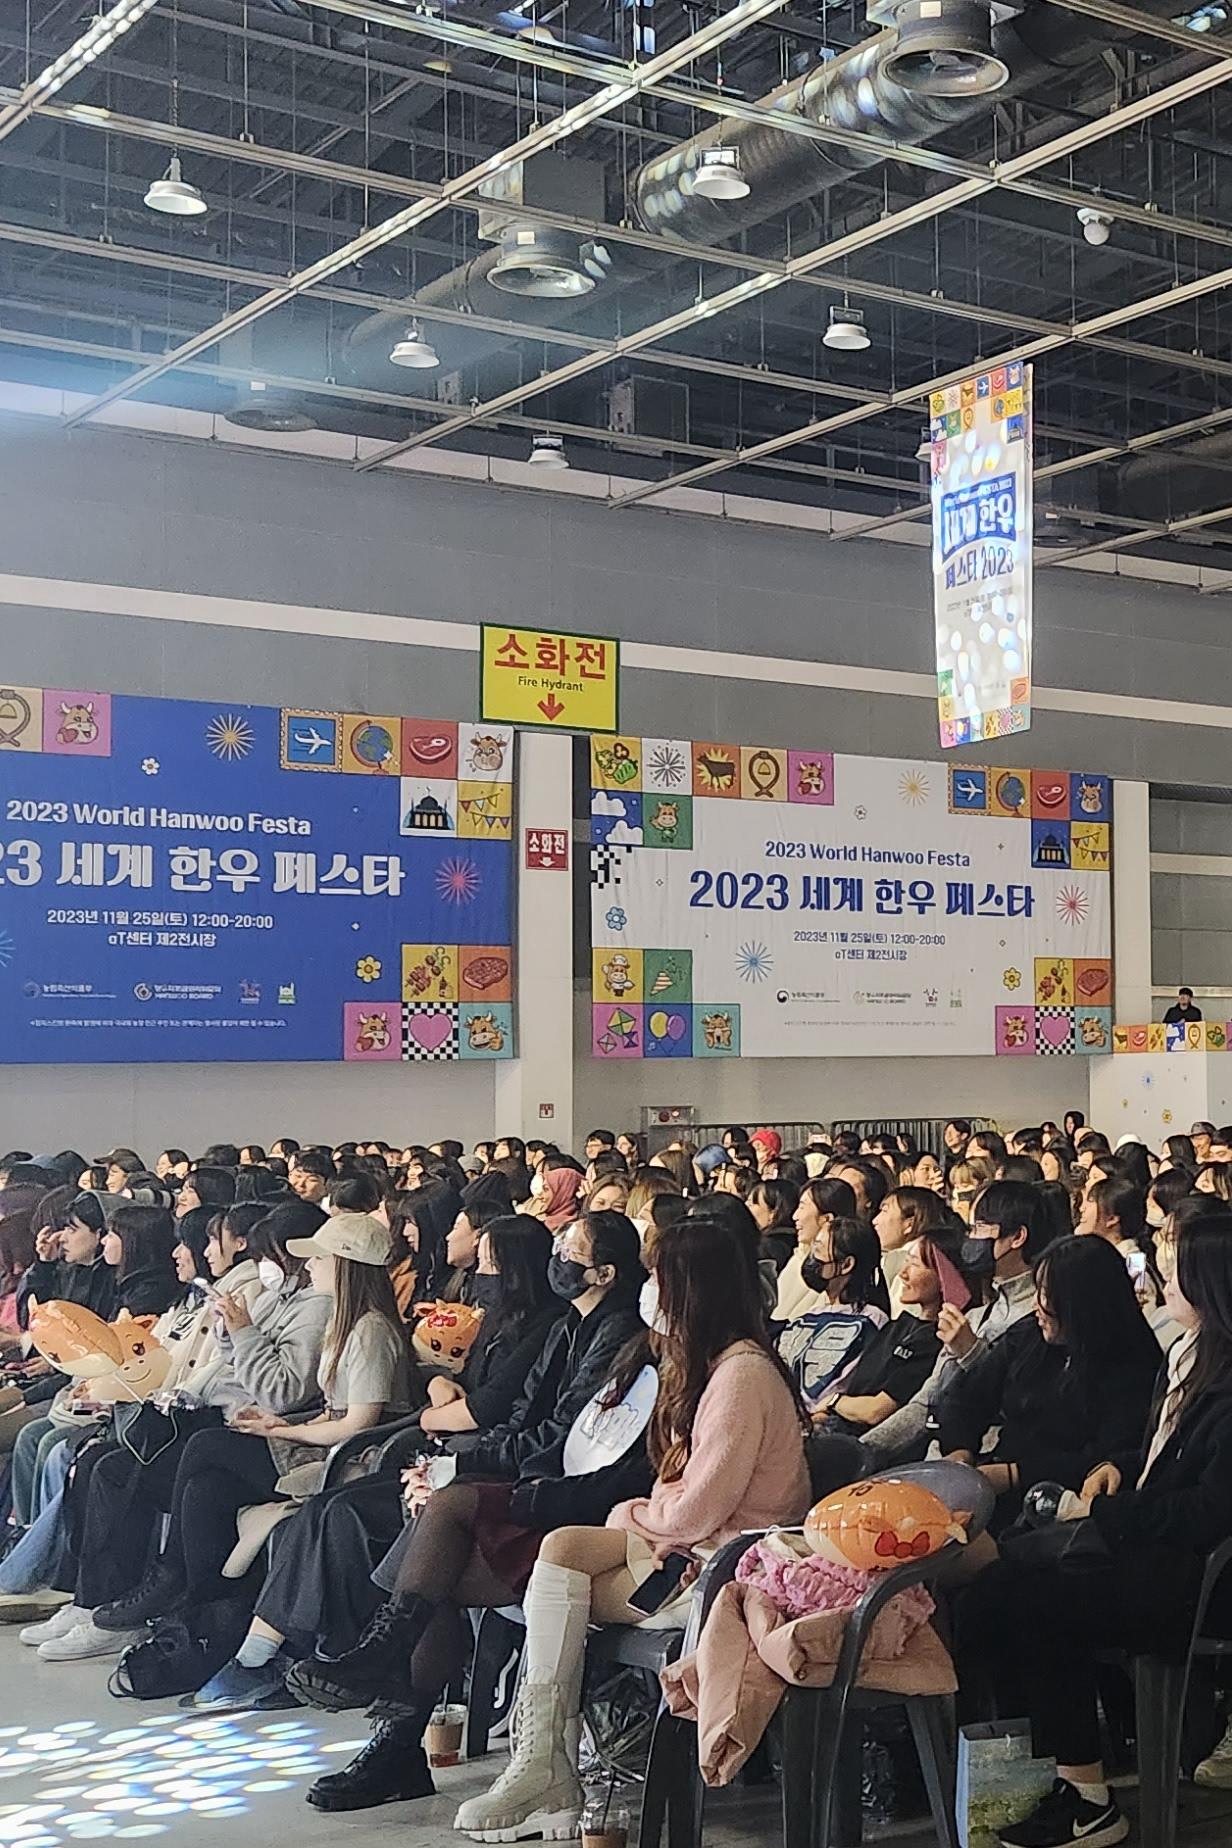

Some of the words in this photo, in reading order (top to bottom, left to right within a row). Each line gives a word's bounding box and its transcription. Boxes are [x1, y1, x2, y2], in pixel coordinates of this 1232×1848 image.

[979, 493, 1014, 534] 한우
[981, 545, 1014, 580] 2023
[494, 633, 606, 680] 소화전
[518, 676, 538, 687] Fire
[541, 679, 584, 692] Hydrant
[6, 800, 68, 823] 2023
[73, 803, 145, 827] World
[150, 808, 243, 832] Hanwoo
[248, 813, 311, 835] Festa
[529, 832, 565, 854] 소화전
[765, 840, 807, 858] 2023
[810, 843, 858, 862] World
[861, 846, 924, 865] Hanwoo
[928, 850, 970, 867] Festa
[0, 839, 43, 887] 3
[56, 841, 153, 888] 세계
[168, 846, 261, 893] 한우
[273, 851, 406, 897] 페스타
[689, 870, 789, 911] 2023
[800, 875, 863, 911] 세계
[874, 878, 937, 915] 한우
[945, 882, 1036, 918] 페스타
[48, 910, 98, 924] 2023년
[102, 910, 129, 925] 11월
[133, 911, 187, 926] 25일(토)
[192, 913, 273, 929] 12:00-20:00
[156, 931, 216, 947] 제2전시장
[793, 930, 828, 942] 2023년
[890, 934, 946, 945] 12:00-20:00
